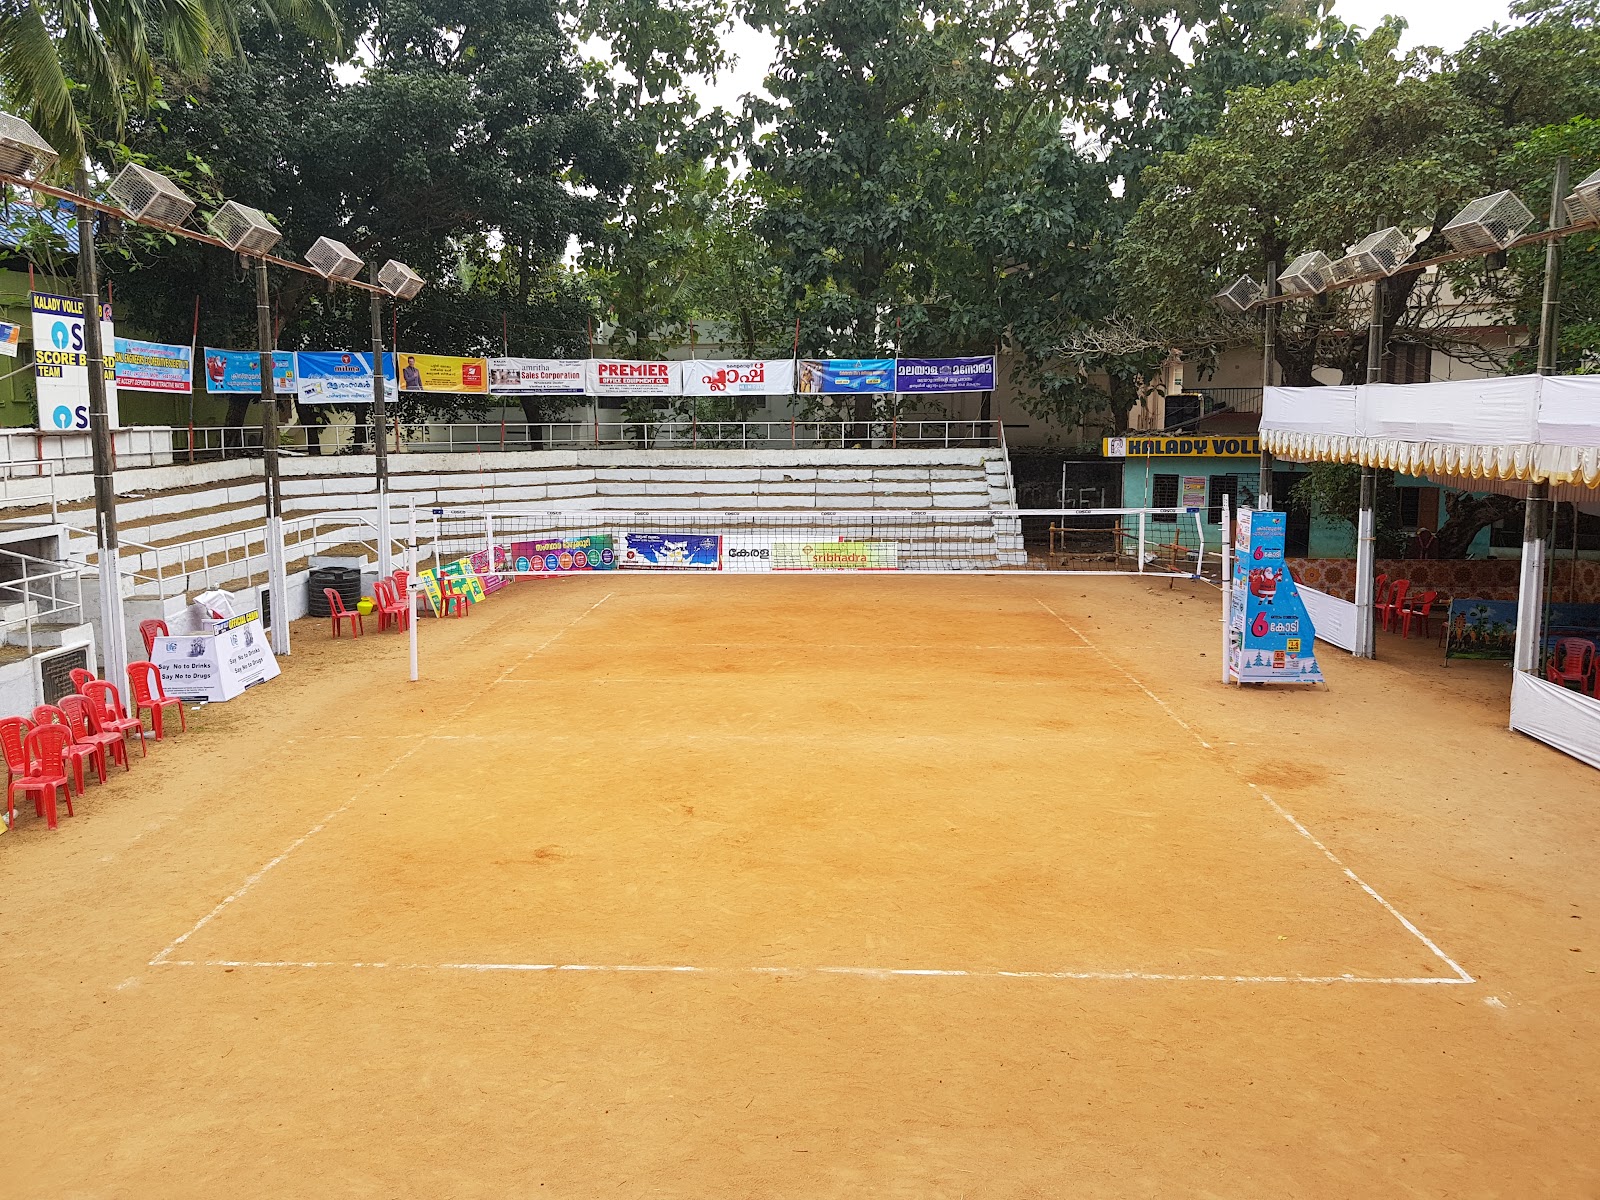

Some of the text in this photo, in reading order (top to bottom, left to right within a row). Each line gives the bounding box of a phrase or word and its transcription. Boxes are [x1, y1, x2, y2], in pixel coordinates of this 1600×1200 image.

[33, 296, 60, 311] KALADY
[62, 300, 85, 314] VOLLE
[36, 351, 115, 368] SCORE BRD
[38, 366, 60, 377] TEAM
[521, 371, 580, 380] Sales Corporation
[598, 364, 668, 376] PREMIER
[1128, 439, 1261, 455] KALADY VOLL
[729, 548, 769, 559] കേരള
[813, 553, 867, 562] sribhadra
[229, 615, 247, 629] OFFICIAL
[248, 648, 261, 657] Drinks
[253, 657, 264, 666] Drugs
